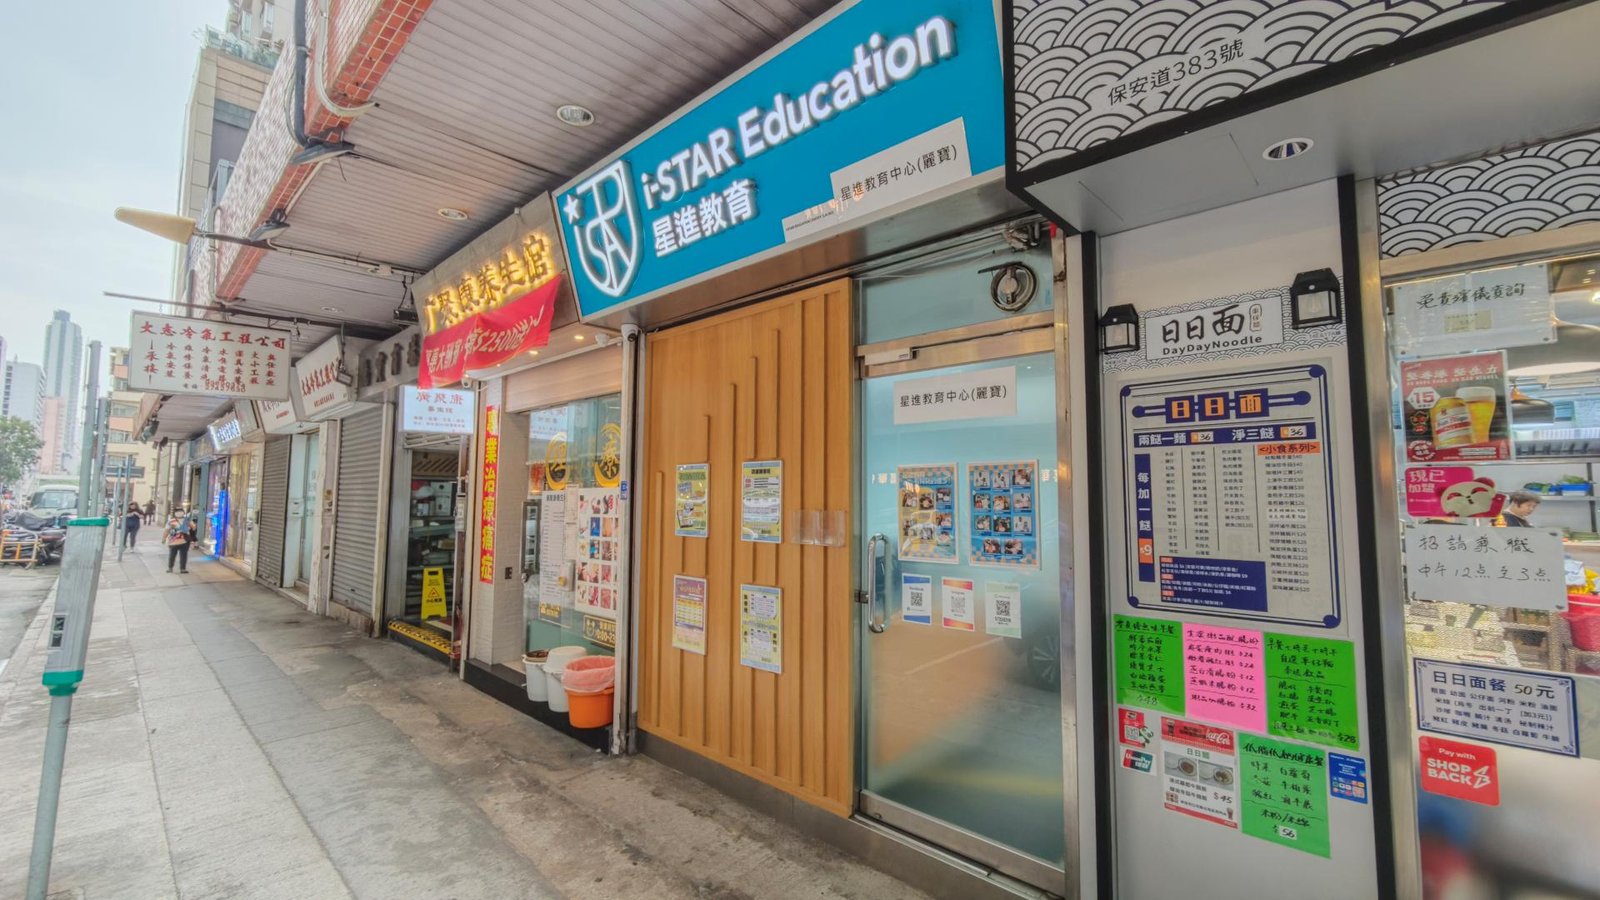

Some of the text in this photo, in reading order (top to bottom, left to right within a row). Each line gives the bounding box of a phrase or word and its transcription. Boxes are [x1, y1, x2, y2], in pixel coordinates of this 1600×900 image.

[1108, 39, 1244, 105] 保安道383號
[642, 15, 952, 209] i-STAR Education
[841, 144, 957, 201] 星進教育中心(麗寶)
[652, 179, 755, 257] 星進教育
[1162, 305, 1246, 343] 日日面
[1162, 335, 1263, 355] DayDayNoodle
[900, 385, 1007, 408] 星進教育中心(麗寶)
[1409, 469, 1446, 483] 現已
[481, 407, 499, 580] 專業治療痛症
[1408, 483, 1435, 493] 加盟
[1433, 671, 1507, 692] 日日面餐
[1438, 747, 1476, 761] Pay with
[1427, 757, 1471, 774] SHOP
[1428, 769, 1473, 785] BACK
